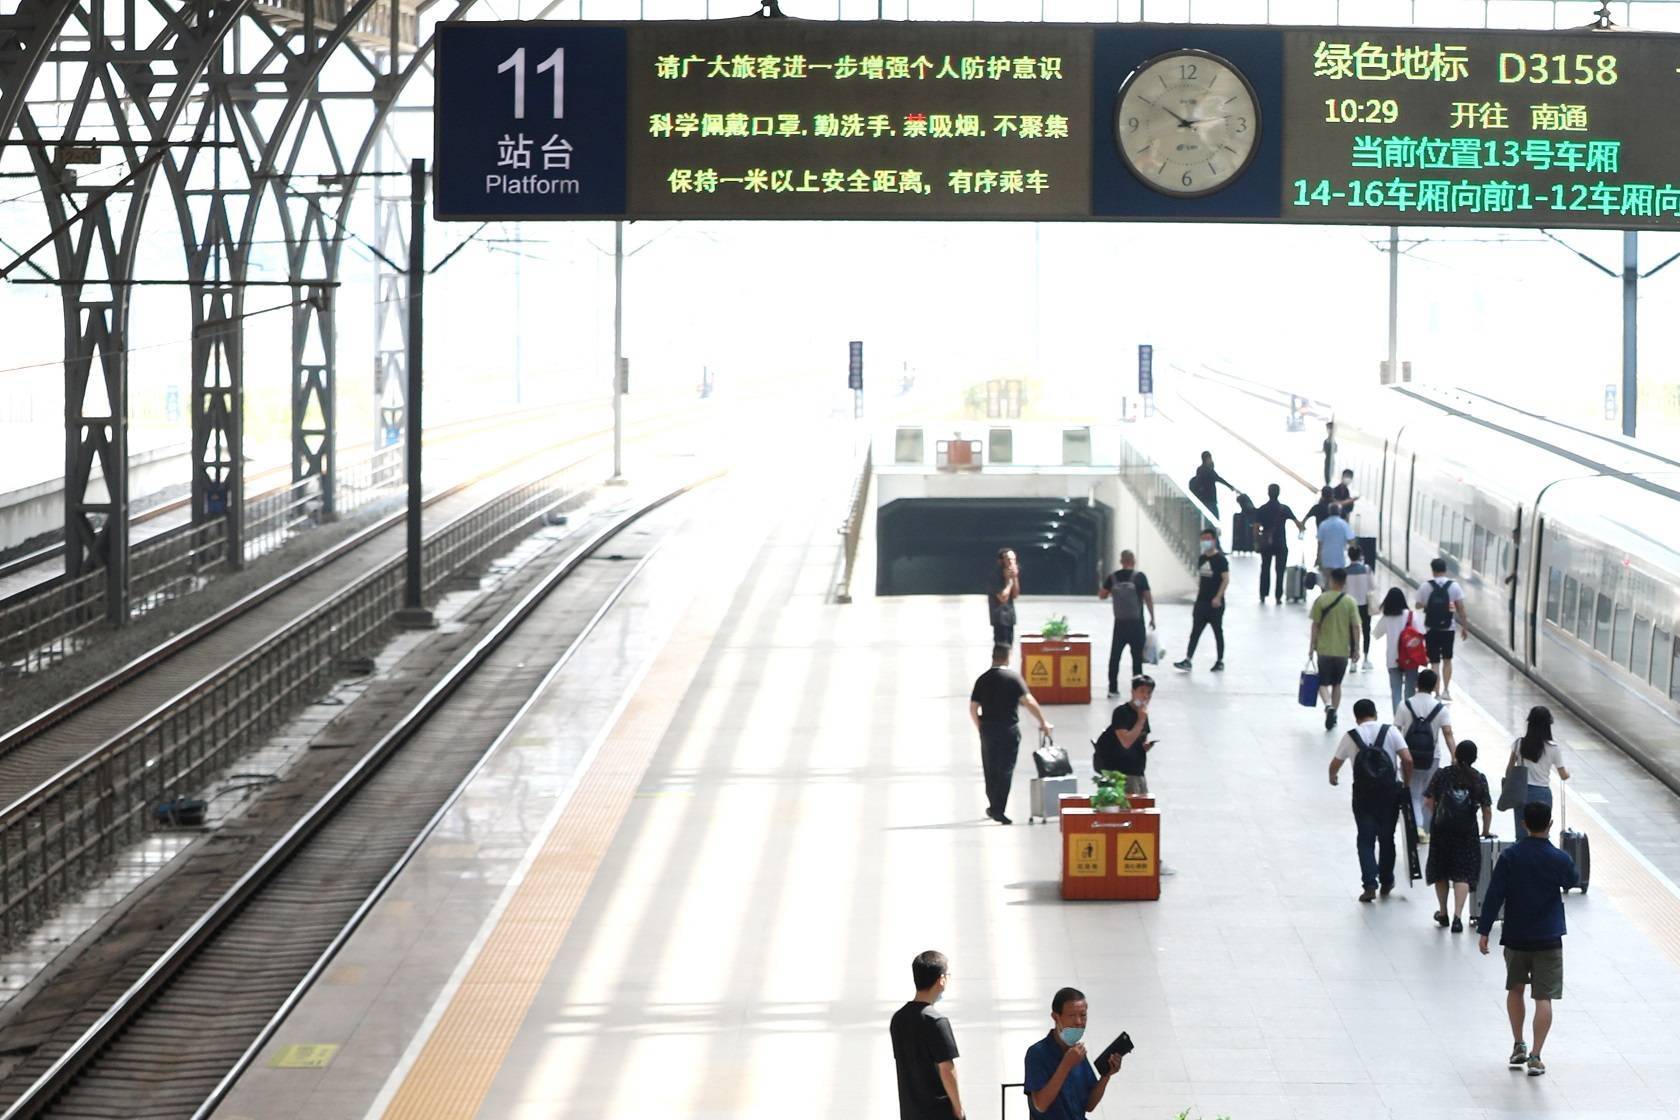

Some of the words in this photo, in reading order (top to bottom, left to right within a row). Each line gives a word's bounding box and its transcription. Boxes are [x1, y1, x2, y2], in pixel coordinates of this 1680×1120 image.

[655, 55, 1063, 80] 请广大旅客进一步增强个人防护意识
[1180, 64, 1197, 80] 12
[1314, 42, 1469, 82] 绿色地标
[1499, 53, 1619, 86] D3158
[497, 47, 565, 119] 11
[1129, 117, 1139, 133] 9
[1236, 117, 1247, 133] 3
[1325, 99, 1399, 124] 10:29
[1450, 102, 1508, 130] 开往
[1531, 103, 1589, 131] 南通
[497, 134, 574, 170] 站台
[1351, 136, 1621, 173] 当前位置13号车厢
[485, 174, 580, 195] Platform
[1182, 170, 1192, 186] 6
